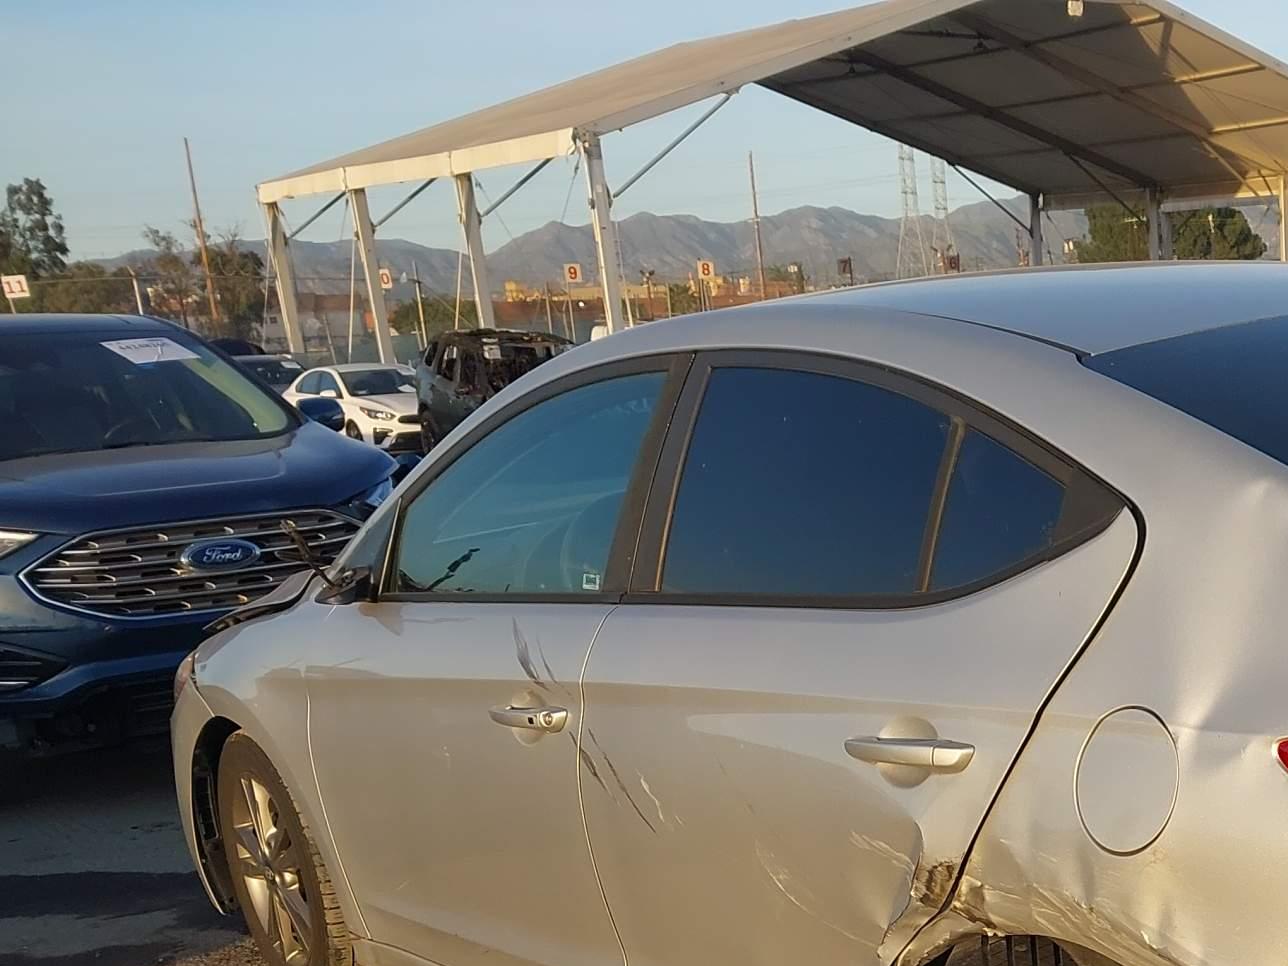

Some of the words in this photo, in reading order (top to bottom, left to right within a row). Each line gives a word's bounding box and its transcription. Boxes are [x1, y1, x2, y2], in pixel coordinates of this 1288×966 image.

[568, 266, 578, 280] 9
[702, 263, 710, 276] 8
[381, 272, 390, 285] 0
[4, 280, 26, 293] 11
[202, 545, 242, 563] Ford
